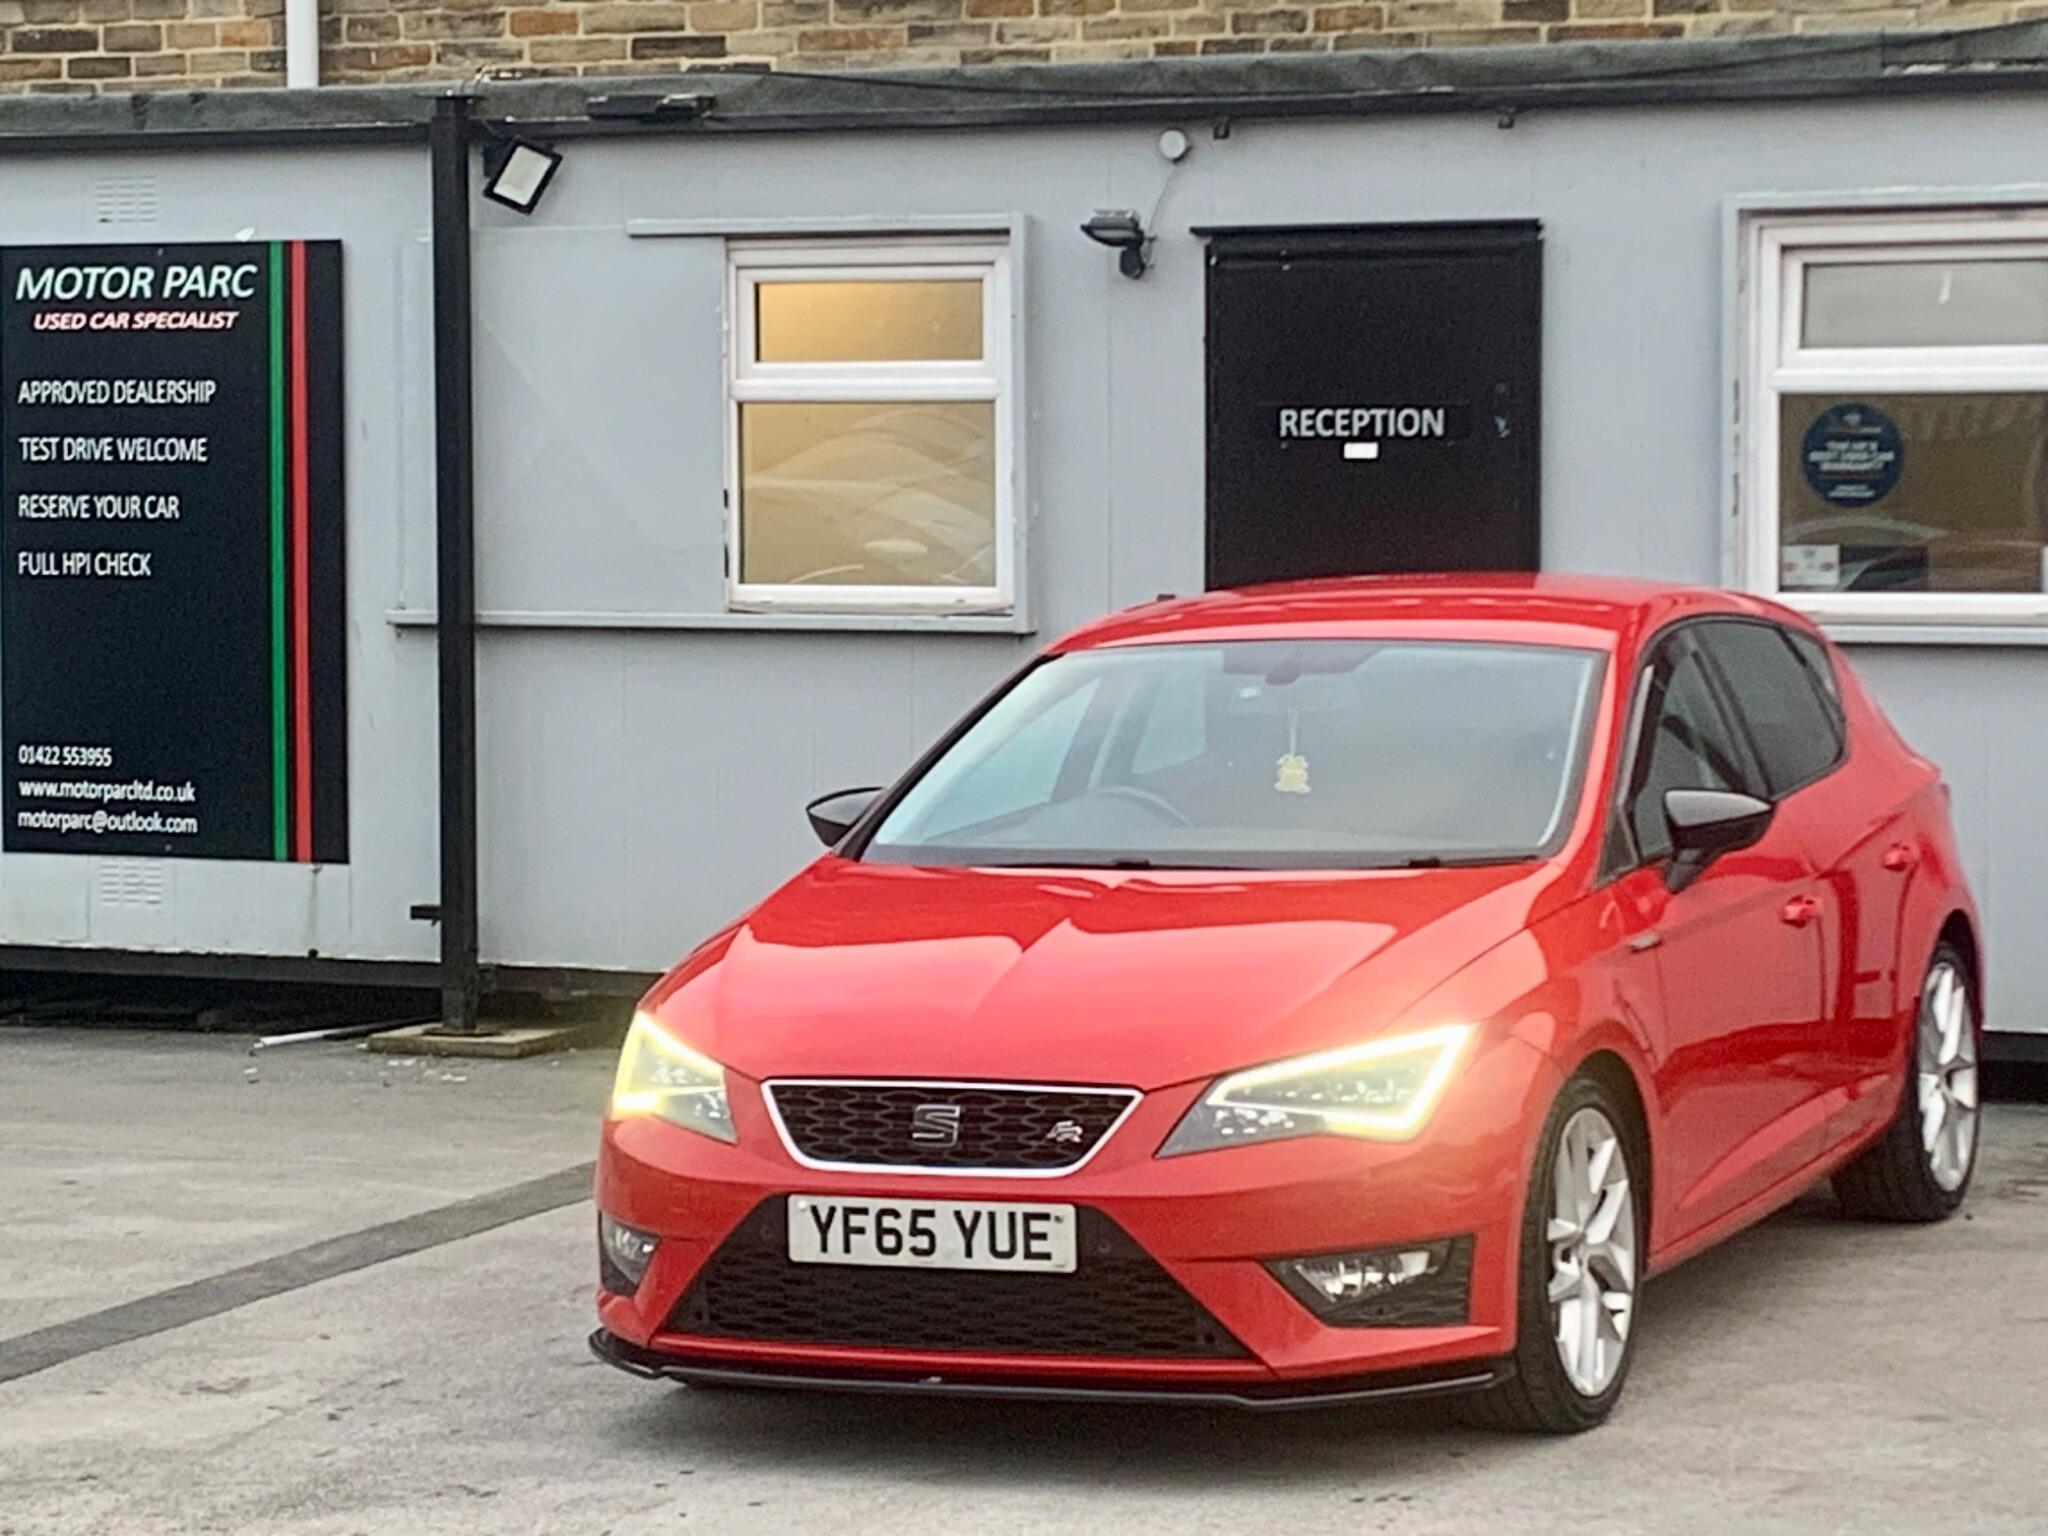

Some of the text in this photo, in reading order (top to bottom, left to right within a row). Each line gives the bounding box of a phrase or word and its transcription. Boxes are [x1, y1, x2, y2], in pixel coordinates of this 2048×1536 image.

[16, 264, 258, 300] MOTOR PARC
[33, 310, 239, 330] USED CAR SPECIALIST
[17, 379, 216, 404] APPROVED DEALERSHIP
[1279, 408, 1445, 437] RECEPTION
[18, 437, 208, 462] TEST DRIVE WELCOME
[18, 494, 180, 519] RESERVE YOUR CAR
[18, 552, 152, 576] FULL HPI CHECK
[18, 745, 112, 767] 01422 553955
[18, 779, 196, 804] www.motorparcltd.co.uk
[17, 810, 198, 833] motorparc@outlook.com
[810, 1205, 1052, 1261] YF65 YUE
